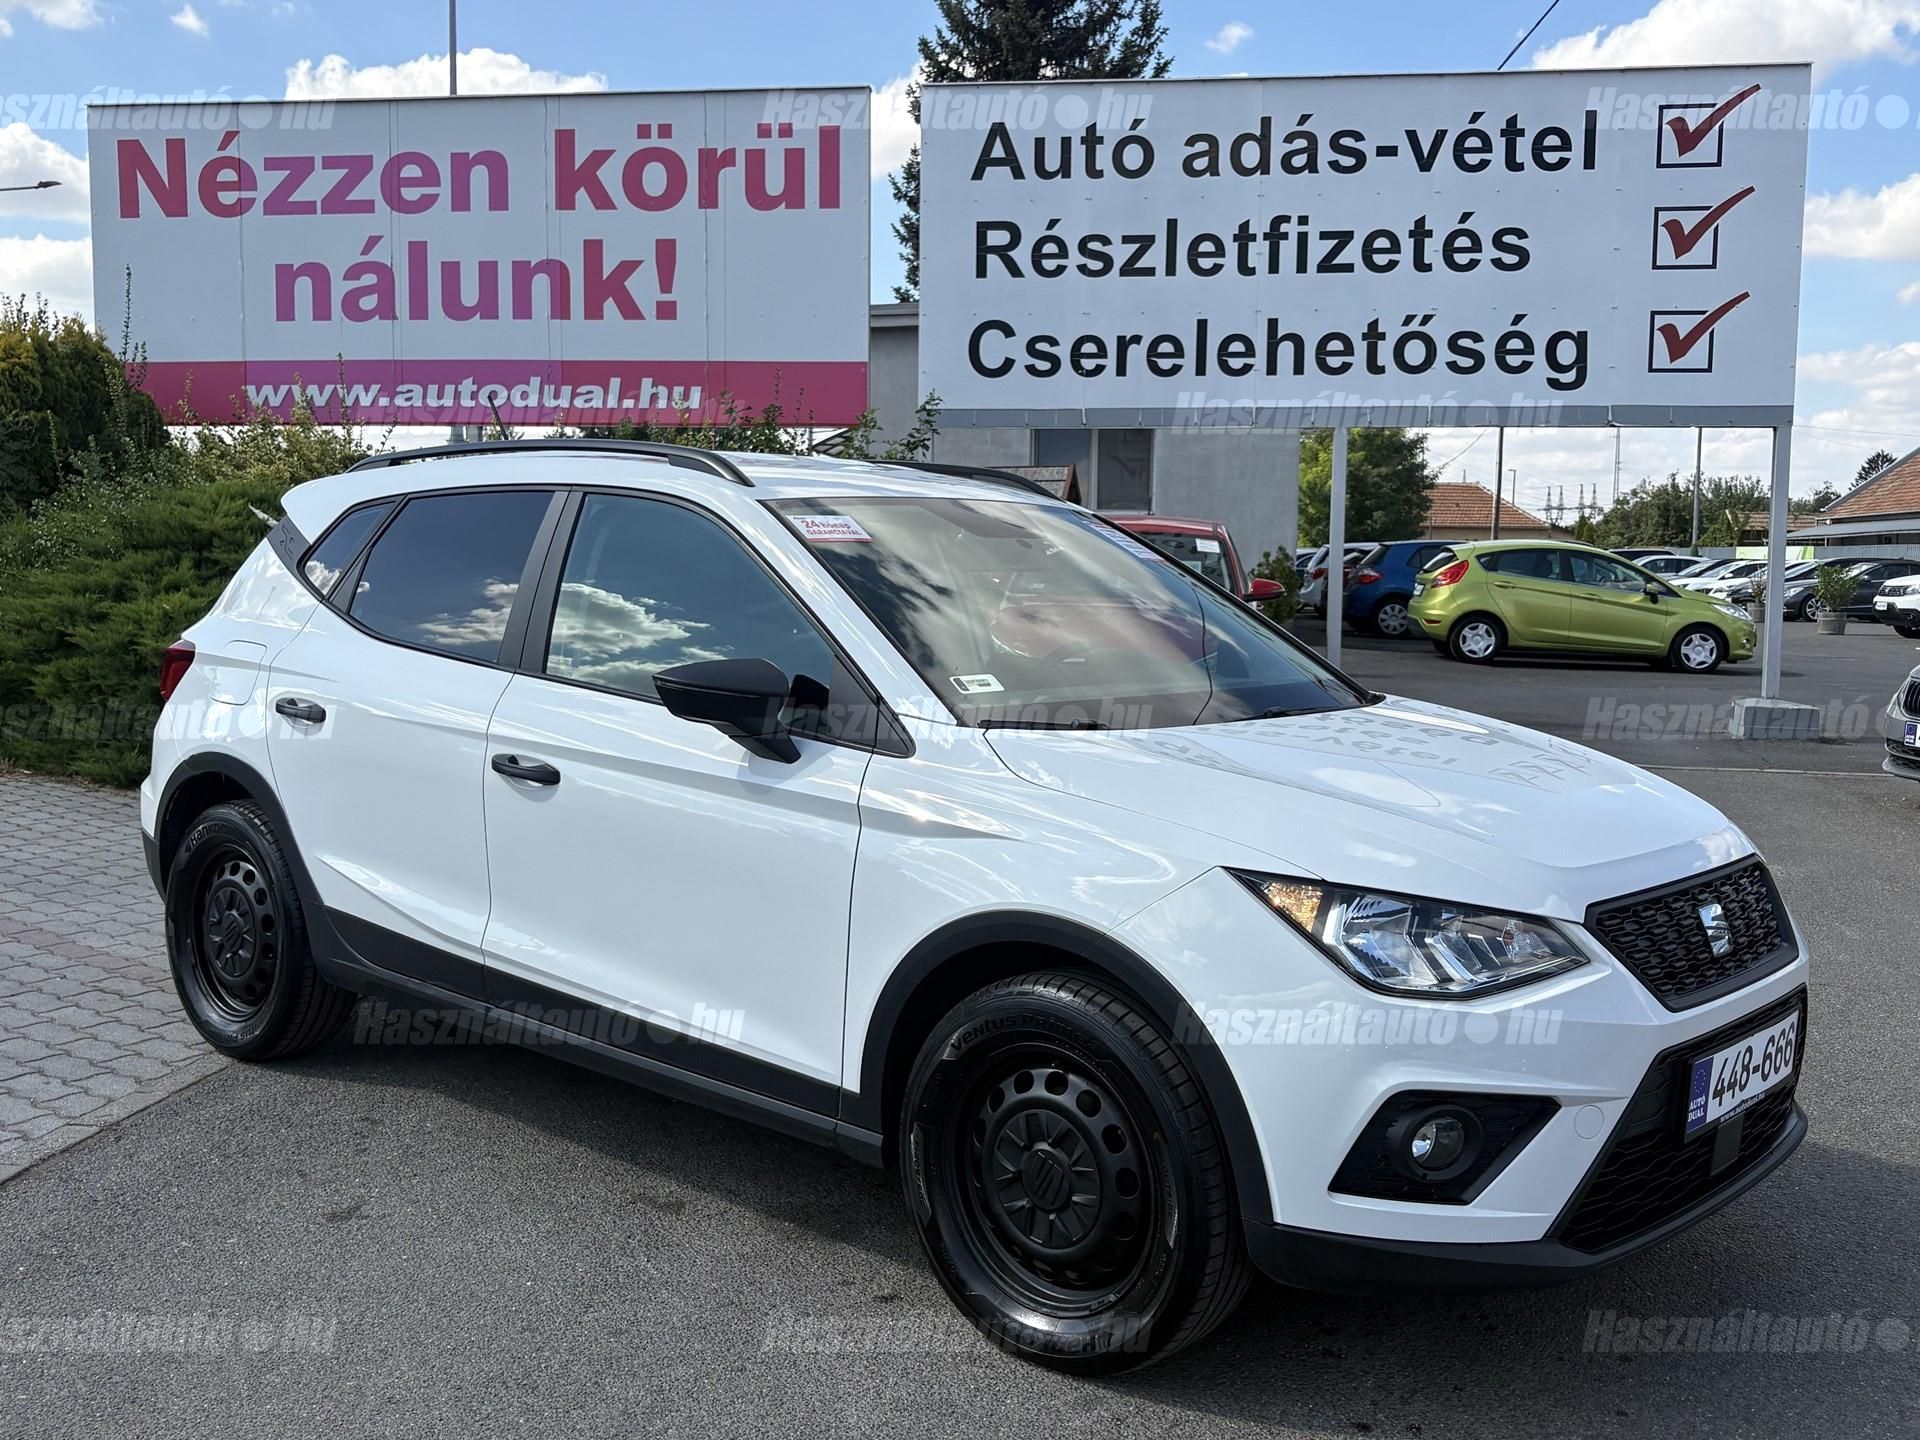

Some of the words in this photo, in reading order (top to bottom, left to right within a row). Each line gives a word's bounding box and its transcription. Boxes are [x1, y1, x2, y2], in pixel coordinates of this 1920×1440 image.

[117, 130, 509, 219] Nézzen
[554, 122, 841, 212] körül
[970, 118, 1156, 182] Autó
[1181, 111, 1598, 178] adás-vétel
[274, 235, 679, 323] nálunk!
[974, 211, 1531, 279] Részletfizetés
[968, 313, 1589, 391] Cserelehetőség
[246, 376, 703, 409] www.autodual.hu
[1713, 1022, 1795, 1106] 448-666
